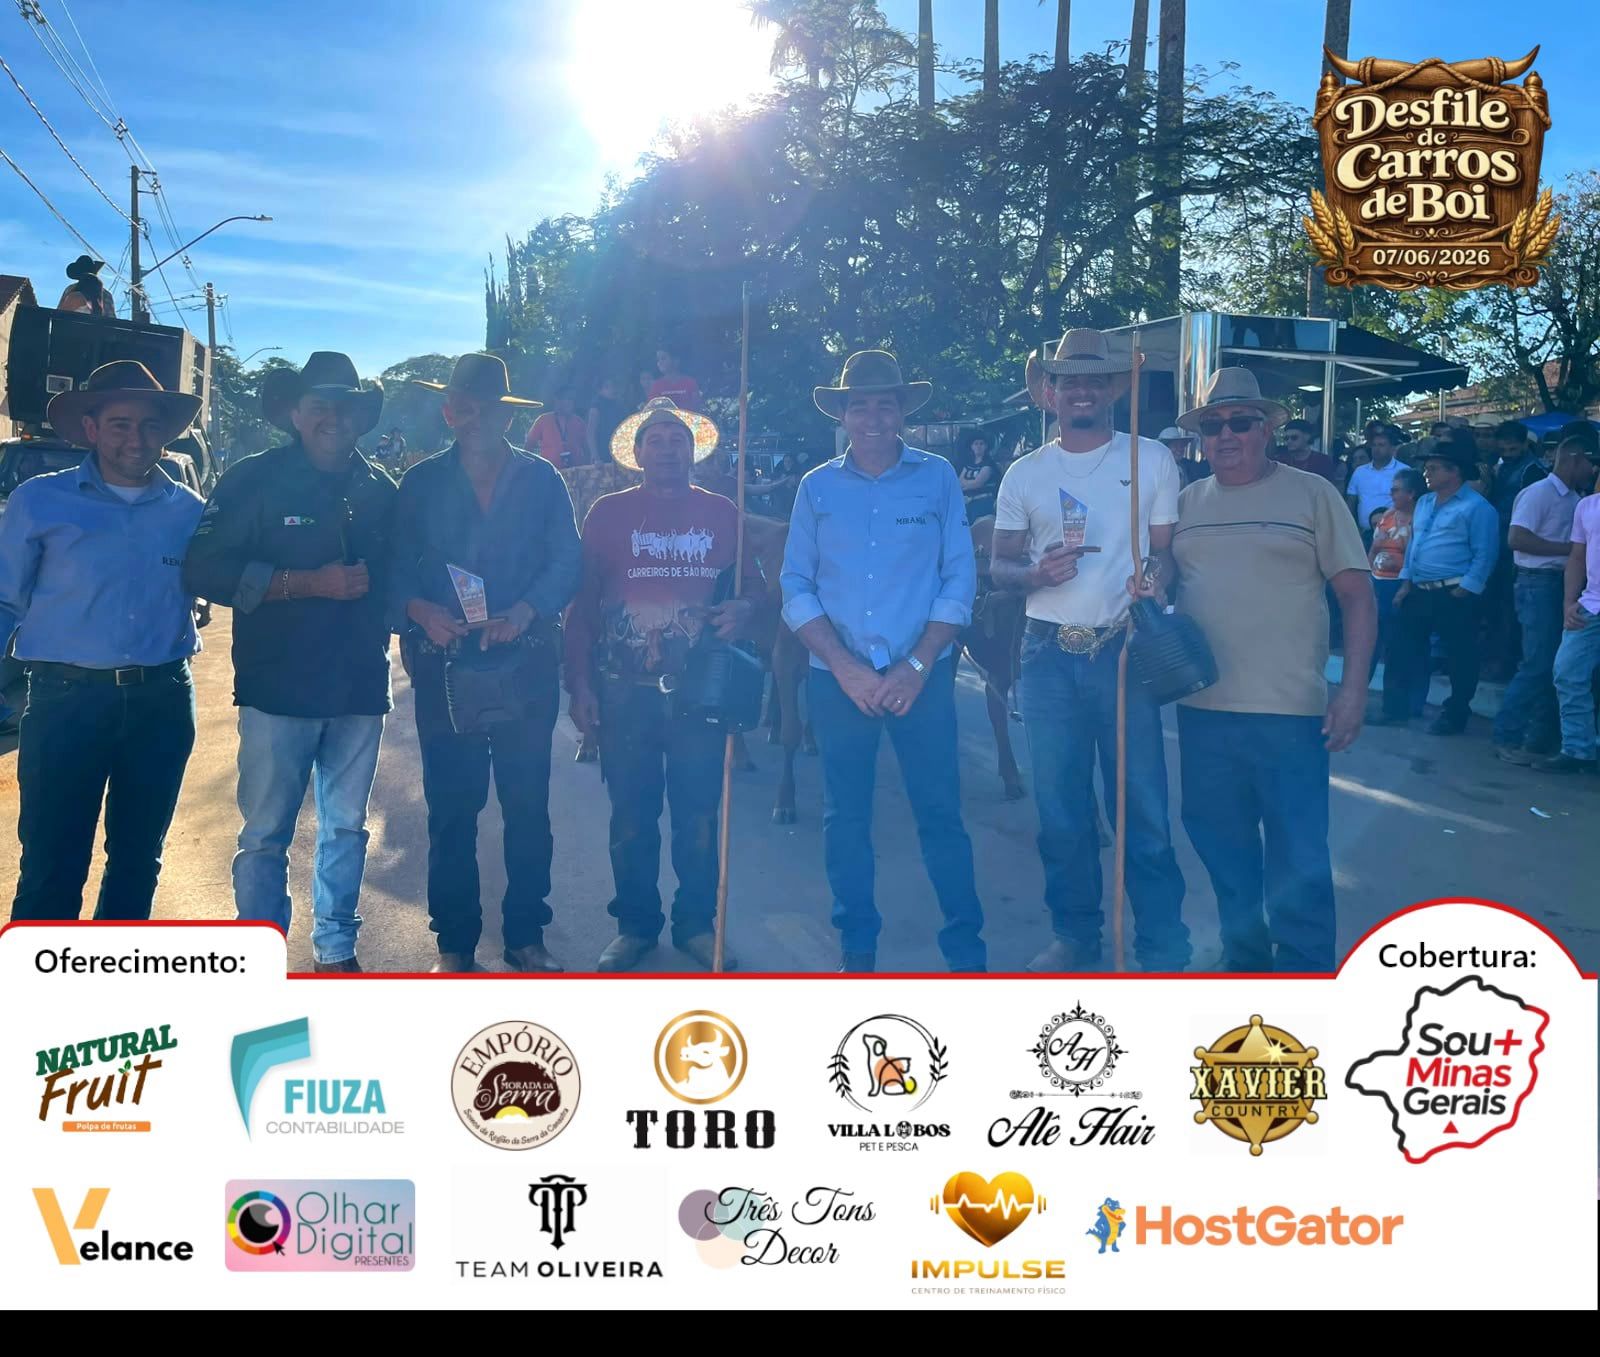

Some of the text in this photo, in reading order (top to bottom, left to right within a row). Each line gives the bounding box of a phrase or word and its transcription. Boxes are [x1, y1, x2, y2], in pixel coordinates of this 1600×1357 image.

[627, 567, 670, 578] CARREIROS
[671, 567, 682, 577] DE
[683, 564, 700, 577] SÃO
